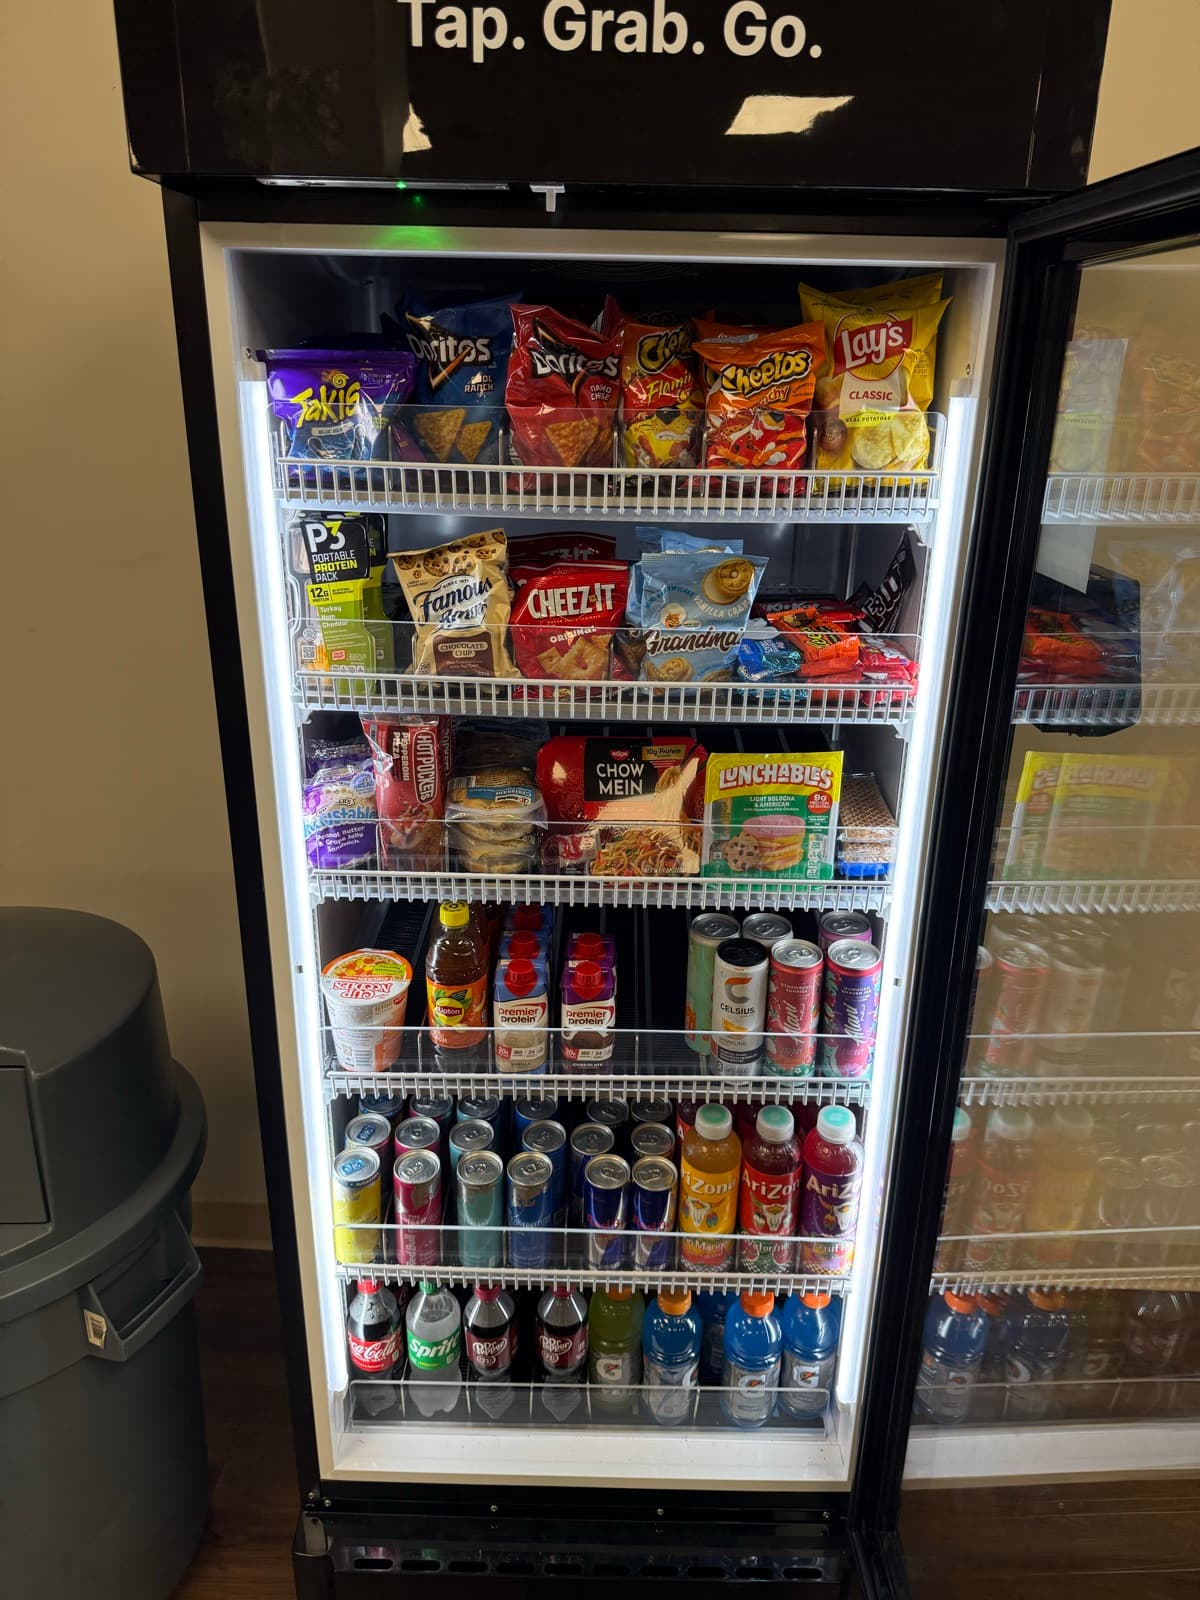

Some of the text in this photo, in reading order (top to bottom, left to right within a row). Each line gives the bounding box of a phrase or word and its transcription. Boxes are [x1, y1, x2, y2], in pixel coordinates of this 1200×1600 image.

[397, 0, 822, 63] Tap. Grab. Go.
[406, 334, 491, 363] Doritos
[841, 321, 905, 366] Lay's
[531, 351, 619, 377] Doritos
[722, 351, 808, 395] Cheetos
[849, 390, 893, 401] CLASSIC
[305, 520, 346, 552] P3
[311, 550, 356, 563] PORTABLE
[313, 560, 358, 574] PROTEIN
[315, 572, 338, 583] PACK
[413, 577, 493, 626] Famous
[440, 642, 485, 651] CHOCOLATE
[401, 732, 410, 781] PEPPERONI
[416, 734, 433, 800] HOT POCKETS
[596, 764, 644, 777] CHOW
[719, 764, 833, 790] LUNCHABLES
[600, 779, 643, 795] MEIN
[333, 981, 392, 993] NOODLES
[341, 989, 374, 999] CUP
[499, 1007, 539, 1018] premier
[567, 1009, 607, 1020] premier
[720, 1003, 755, 1015] CELSIUS
[501, 1015, 536, 1024] protein
[569, 1016, 605, 1025] protein
